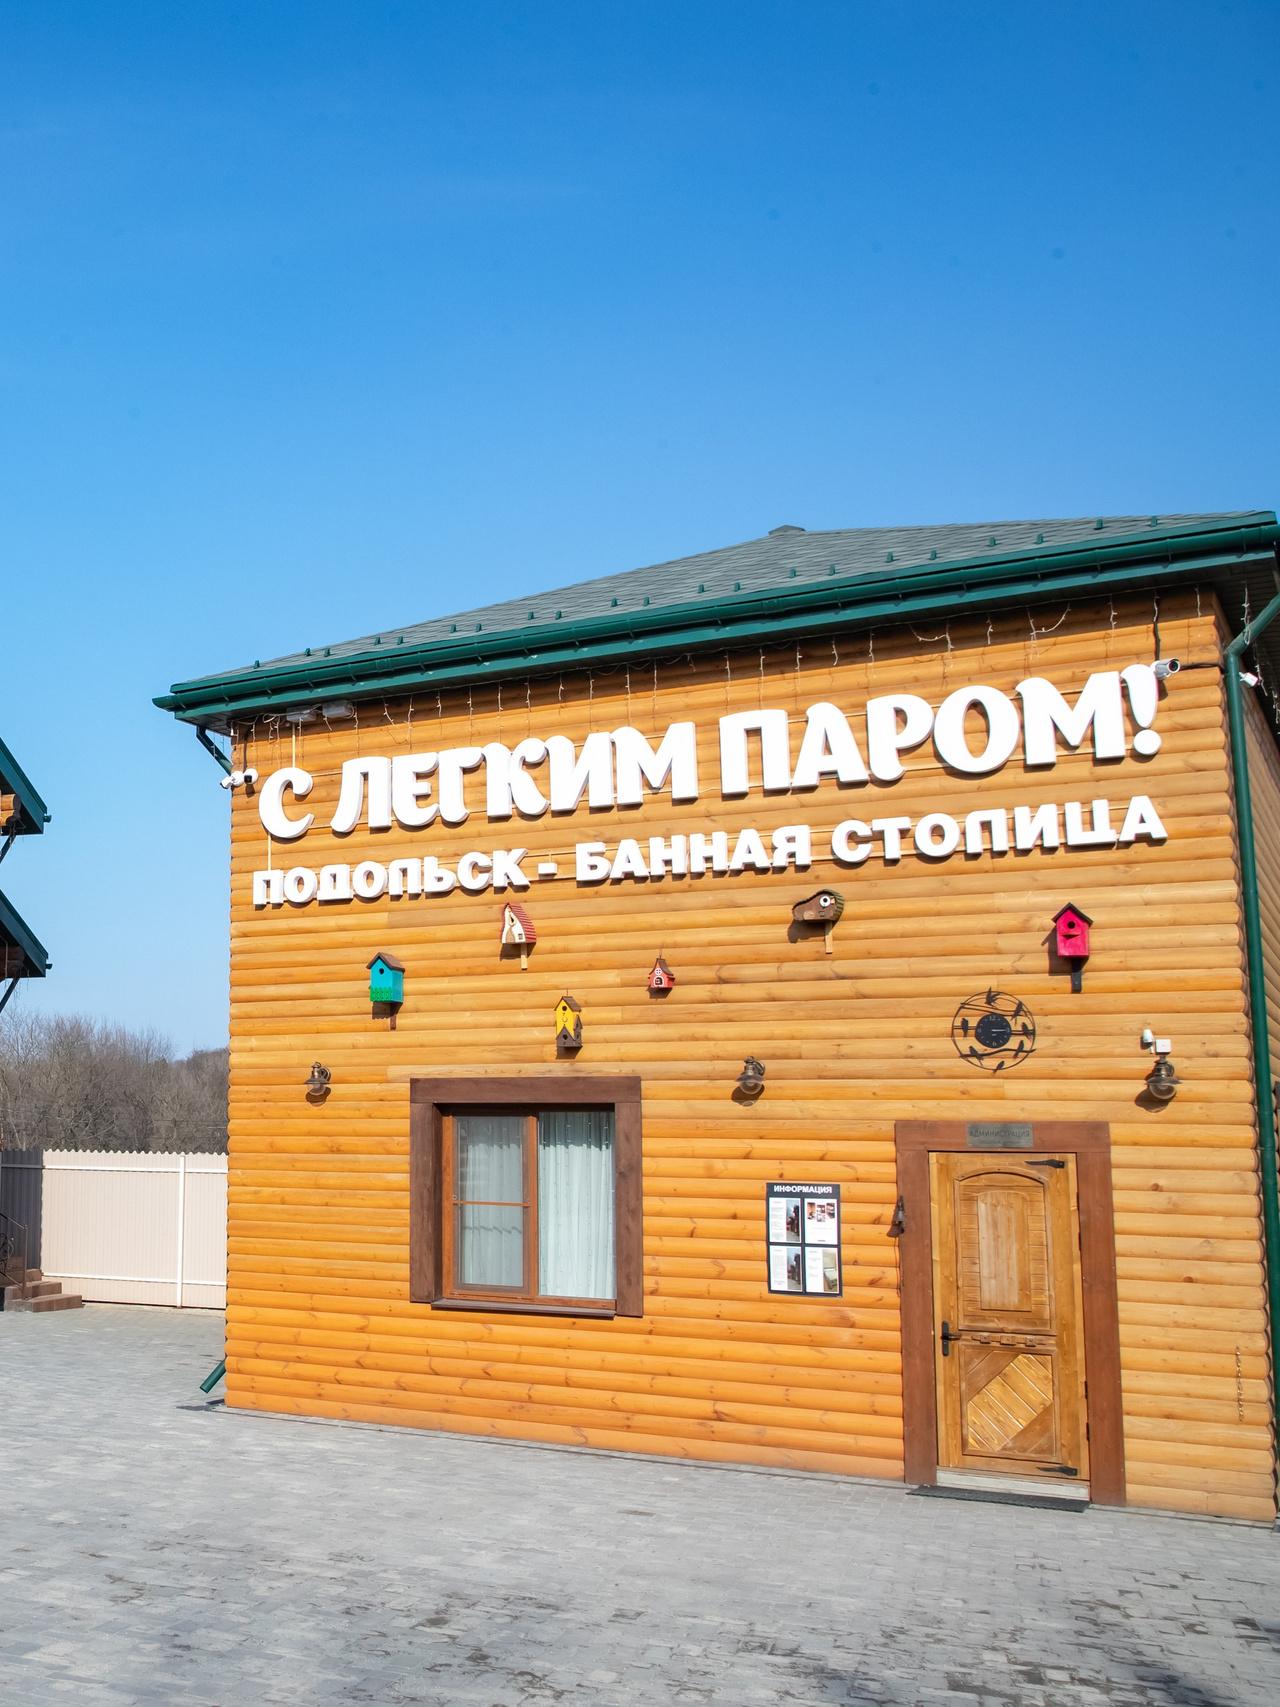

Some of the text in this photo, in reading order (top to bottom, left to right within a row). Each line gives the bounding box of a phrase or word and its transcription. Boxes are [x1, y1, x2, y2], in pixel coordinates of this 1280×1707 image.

[258, 663, 1163, 839] С ЛЕГКИМ ПАРОМ!
[575, 824, 815, 882] БАННАЯ
[969, 1129, 1031, 1138] АДМИНИСТРАЦИЯ
[773, 1184, 833, 1194] ИНФОРМАЦИЯ
